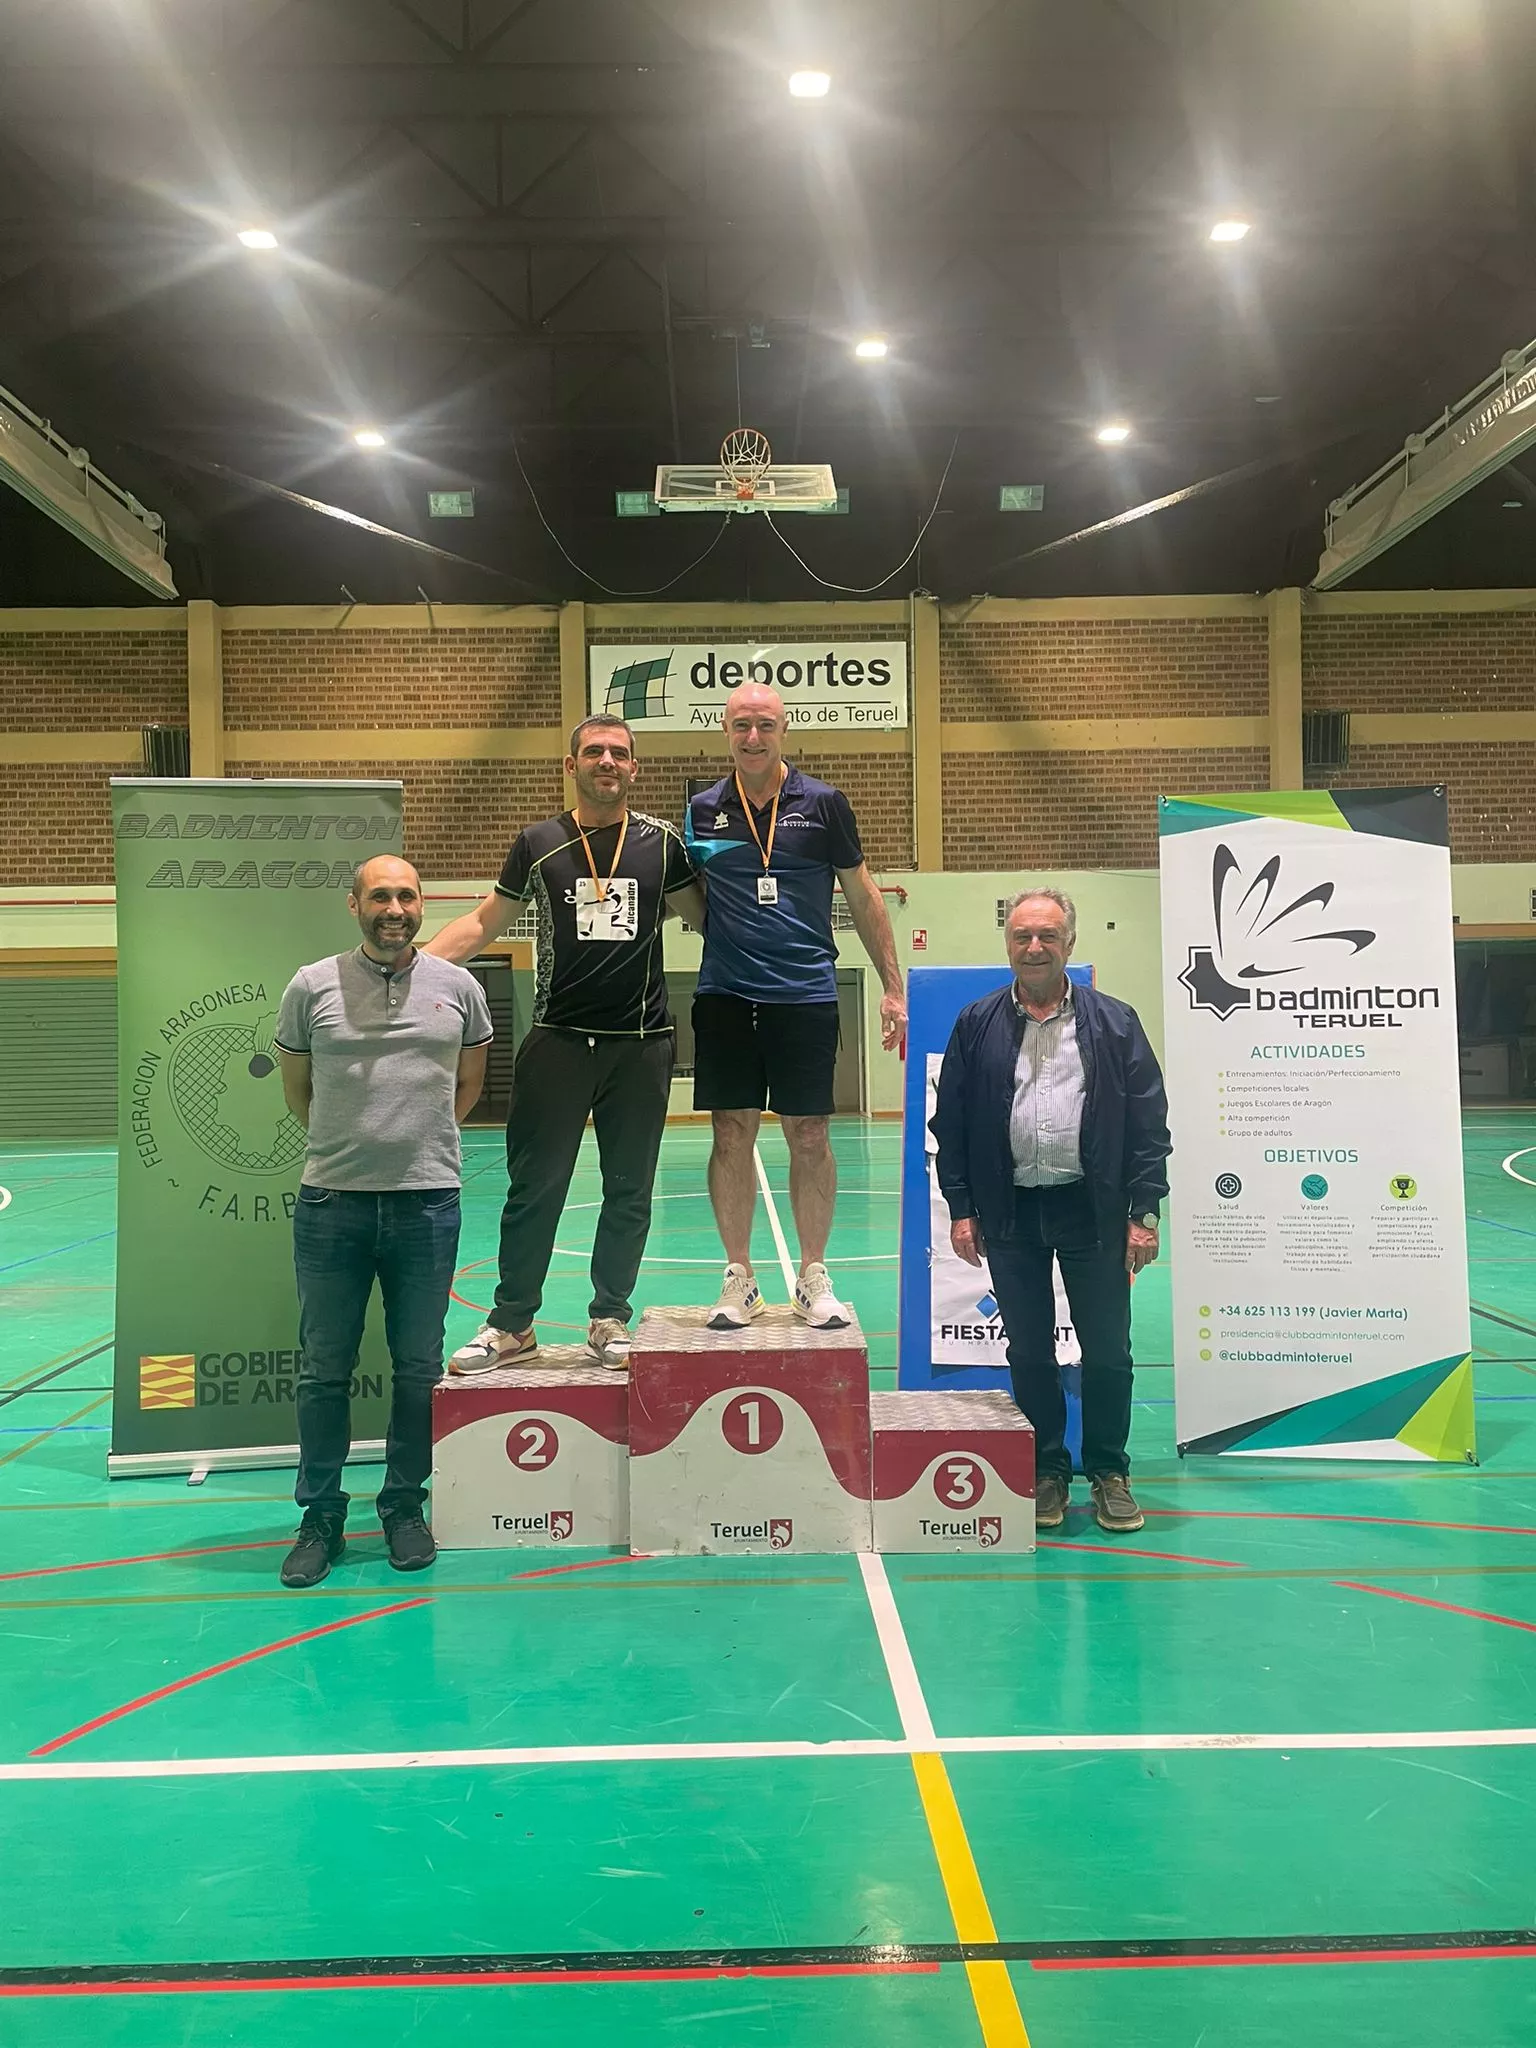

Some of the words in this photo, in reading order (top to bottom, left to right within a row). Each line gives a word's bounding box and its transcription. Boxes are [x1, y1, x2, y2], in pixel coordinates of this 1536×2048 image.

[690, 652, 891, 688] deportes
[817, 707, 839, 722] de
[845, 706, 898, 721] Teruel
[116, 814, 400, 840] BADMINTON
[627, 881, 636, 925] Alcanadre
[1257, 986, 1440, 1011] badminton
[1293, 1013, 1403, 1028] TERUEL
[1250, 1045, 1366, 1059] ACTIVIDADES
[132, 1051, 163, 1168] FEDERACION
[159, 983, 267, 1045] ARAGONESA
[1226, 1085, 1282, 1094] Competiciones
[1227, 1100, 1253, 1108] Juegos
[1292, 1099, 1303, 1107] de
[1304, 1099, 1332, 1108] Aragón
[1227, 1114, 1243, 1122] Alta
[1244, 1114, 1291, 1123] competición
[1228, 1130, 1251, 1138] Grupo
[1252, 1129, 1263, 1137] de
[1264, 1129, 1293, 1137] adultos
[1264, 1149, 1359, 1163] OBJETIVOS
[1380, 1204, 1428, 1212] Competición
[1219, 1306, 1241, 1316] +34
[1244, 1306, 1265, 1316] 625
[1270, 1306, 1291, 1317] 113
[1295, 1307, 1316, 1317] 199
[1319, 1307, 1362, 1320] (Javier
[1365, 1308, 1408, 1321] Marta)
[1219, 1350, 1353, 1363] @clubbadmintoteruel
[200, 1381, 239, 1406] DE
[739, 1401, 760, 1445] 1
[519, 1427, 546, 1464] 2
[946, 1465, 974, 1502] 3
[492, 1513, 548, 1530] Teruel
[710, 1521, 767, 1537] Teruel
[919, 1519, 976, 1535] Teruel
